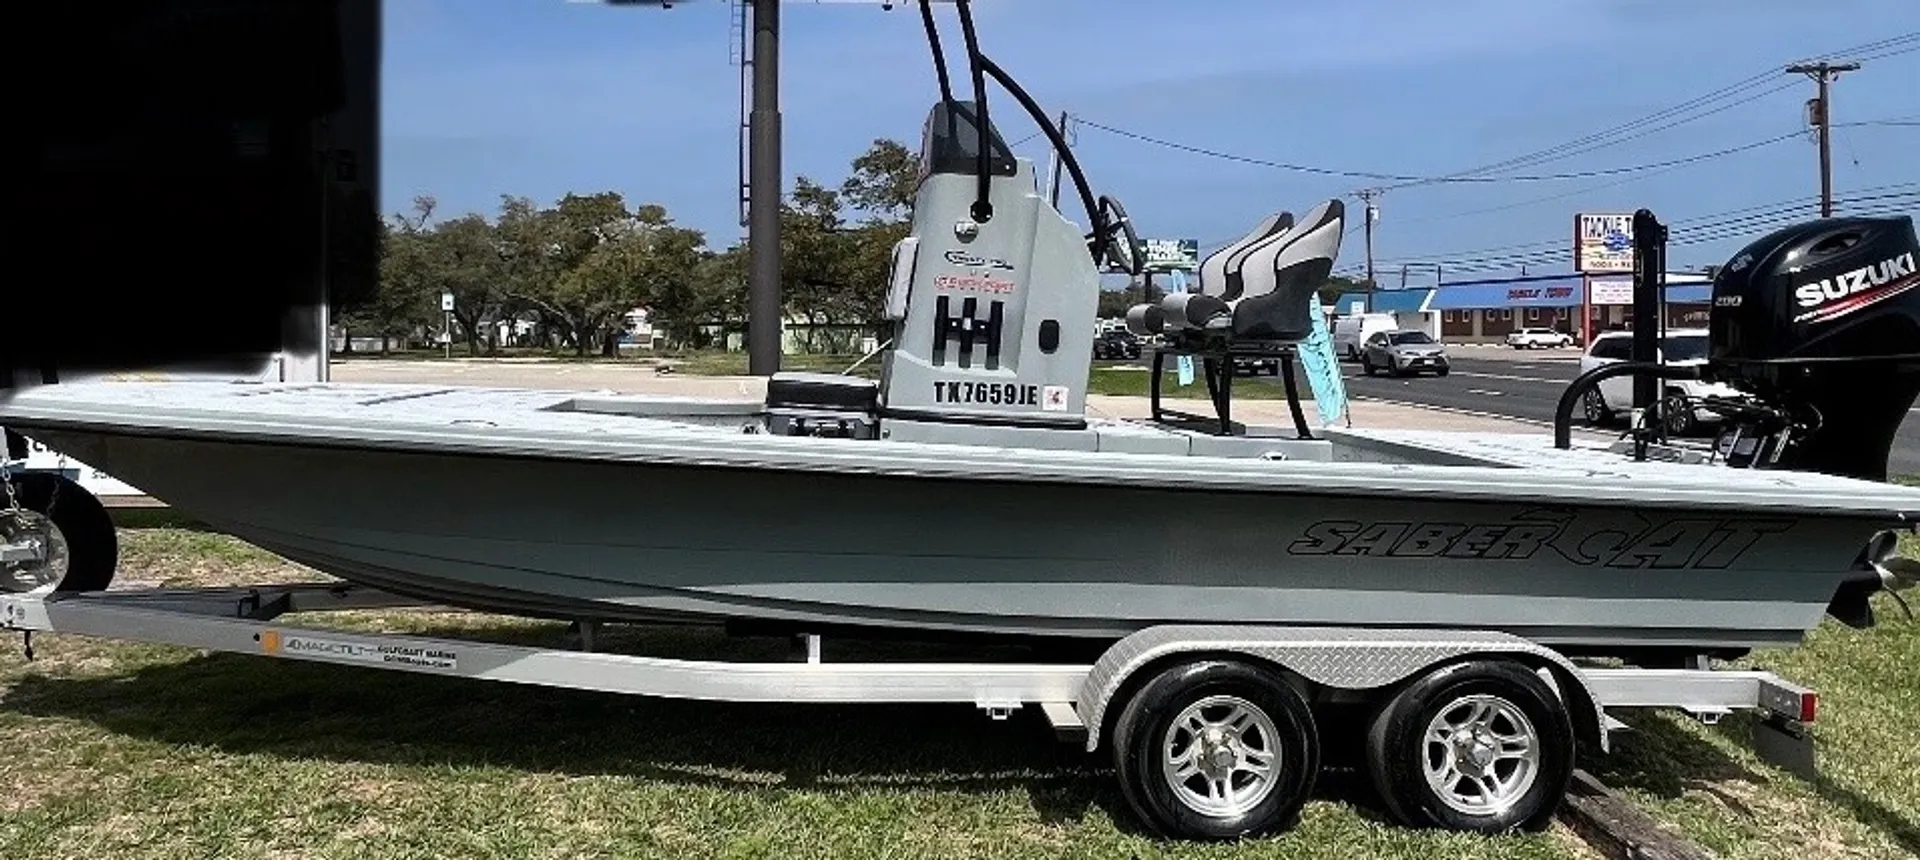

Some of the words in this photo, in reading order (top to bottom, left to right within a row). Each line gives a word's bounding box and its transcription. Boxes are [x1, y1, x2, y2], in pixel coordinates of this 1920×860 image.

[1583, 217, 1622, 238] TACKLE
[1795, 251, 1917, 307] SUZUKI
[1715, 295, 1743, 307] 200
